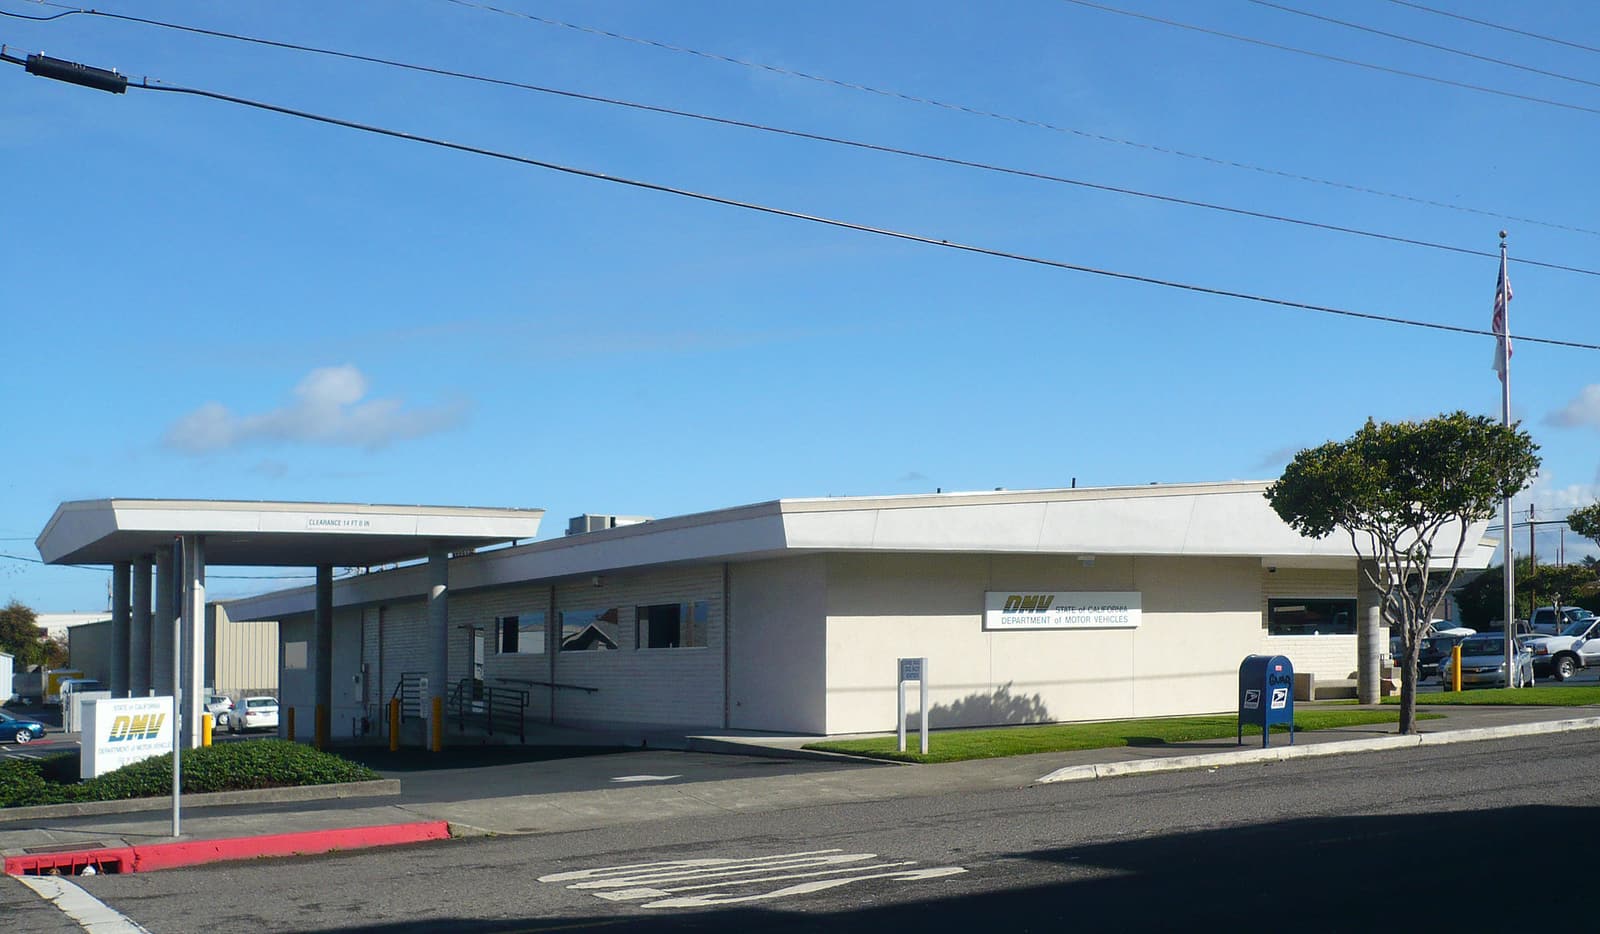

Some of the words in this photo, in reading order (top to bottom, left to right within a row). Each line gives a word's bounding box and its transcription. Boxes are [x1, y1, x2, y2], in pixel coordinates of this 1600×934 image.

[1002, 595, 1055, 614] DMV
[1055, 606, 1076, 614] STATE
[1087, 605, 1128, 613] CALIFORNIA
[1001, 616, 1050, 625] DEPARTMENT
[1054, 616, 1062, 624] of
[1065, 616, 1091, 624] MOTOR
[1094, 615, 1129, 624] VEHICLES
[108, 713, 165, 742] DMV
